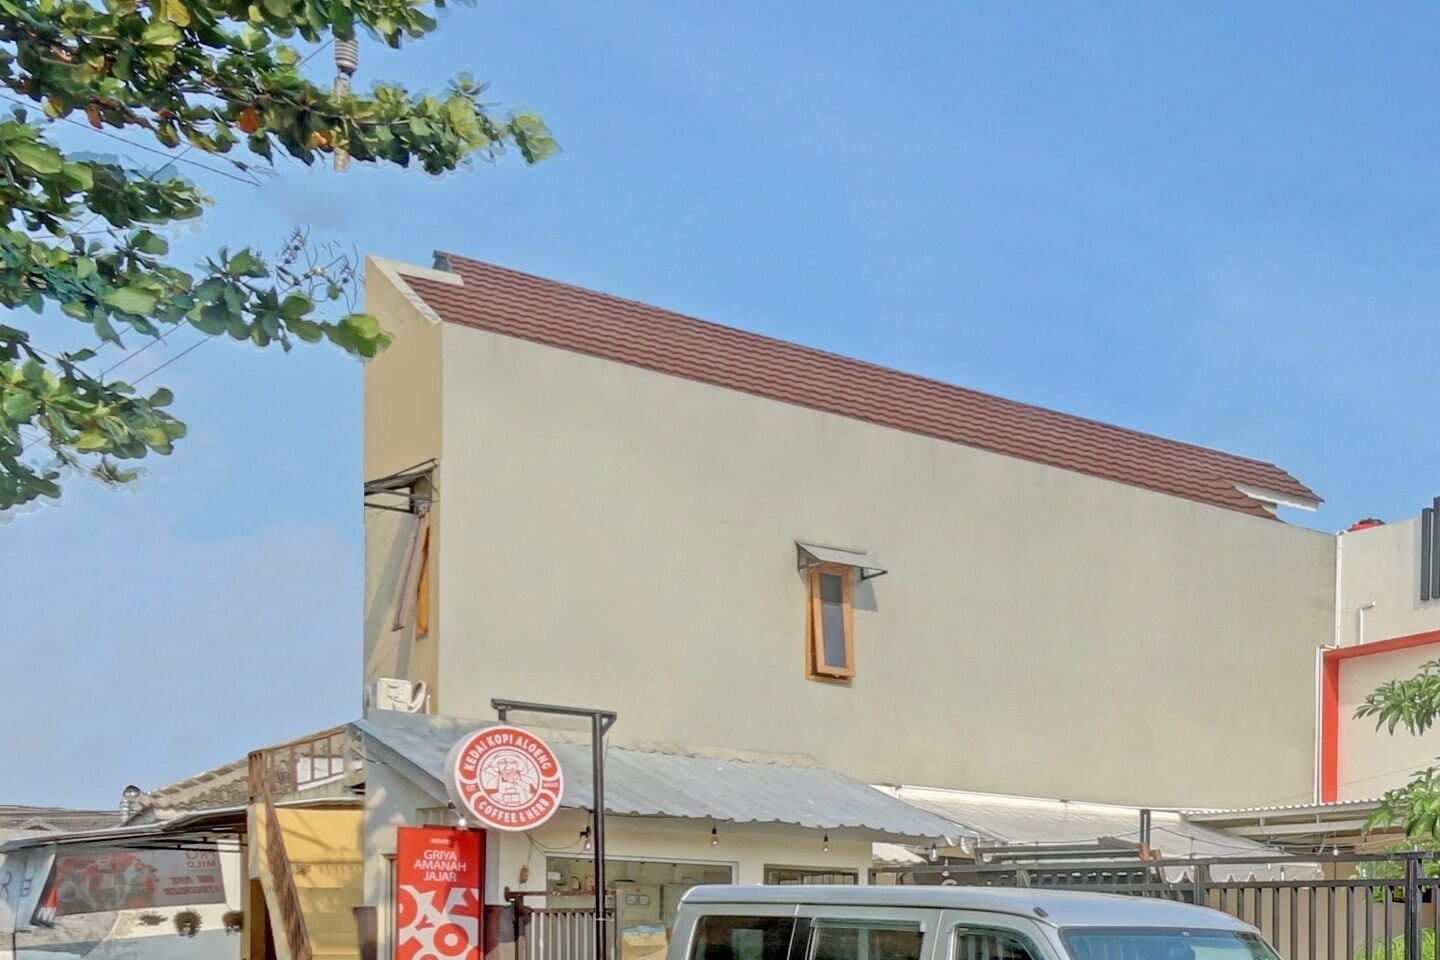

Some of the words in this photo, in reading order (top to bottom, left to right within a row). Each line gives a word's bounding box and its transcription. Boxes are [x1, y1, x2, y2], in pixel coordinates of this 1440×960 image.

[464, 740, 488, 772] KEDAI
[486, 733, 513, 747] KOPI
[515, 736, 552, 770] ALOENG
[479, 801, 518, 823] COFFEE
[525, 798, 550, 820] HERB
[423, 849, 457, 862] GRIYA
[413, 859, 467, 872] AMANAH
[423, 871, 457, 883] JAJAR
